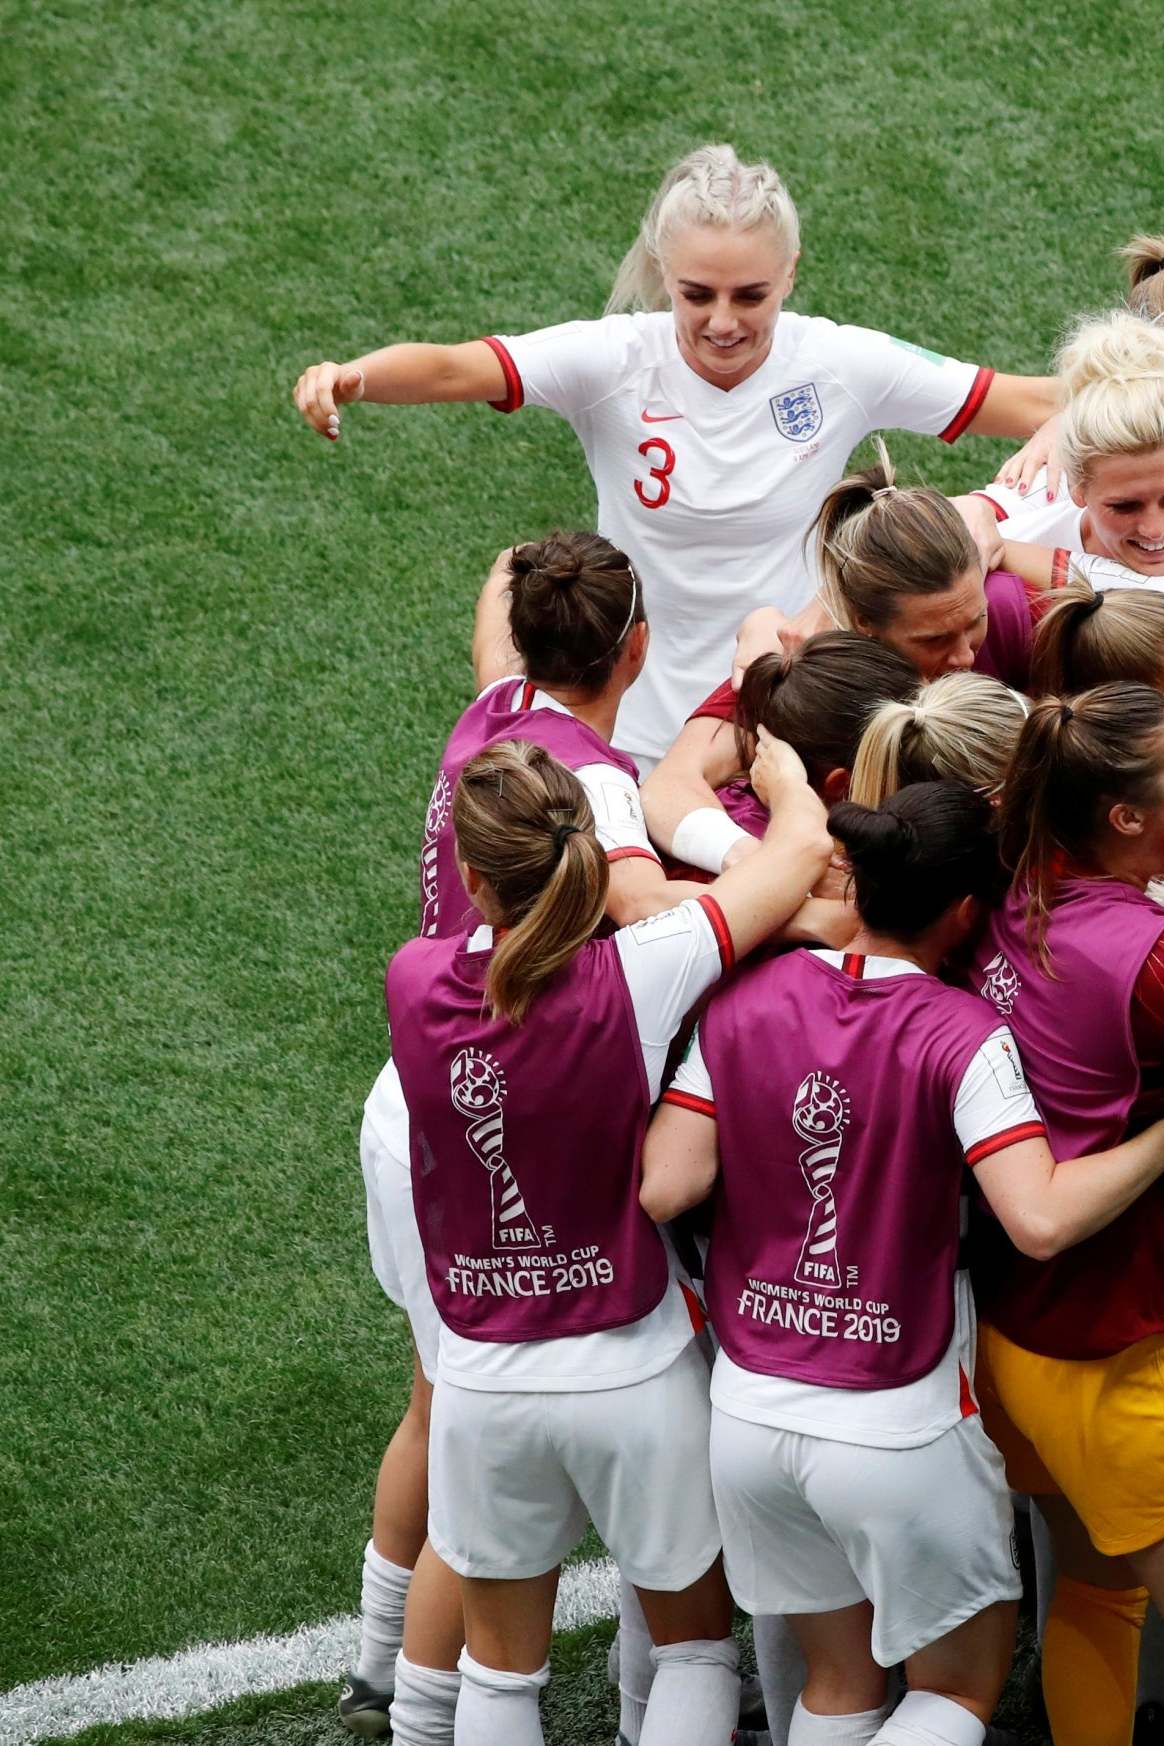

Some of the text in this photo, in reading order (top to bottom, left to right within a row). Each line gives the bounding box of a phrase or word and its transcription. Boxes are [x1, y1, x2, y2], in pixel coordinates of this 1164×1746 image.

[634, 437, 676, 509] 3
[499, 1228, 535, 1243] FIFA
[517, 1253, 568, 1268] WORLD
[571, 1245, 600, 1261] CUP
[803, 1261, 836, 1282] FIFA
[445, 1257, 615, 1298] FRANCE 2019
[846, 1265, 859, 1288] TM
[748, 1278, 890, 1315] WOMEN'S WORLD CUP
[736, 1289, 902, 1344] FRANCE 2019
